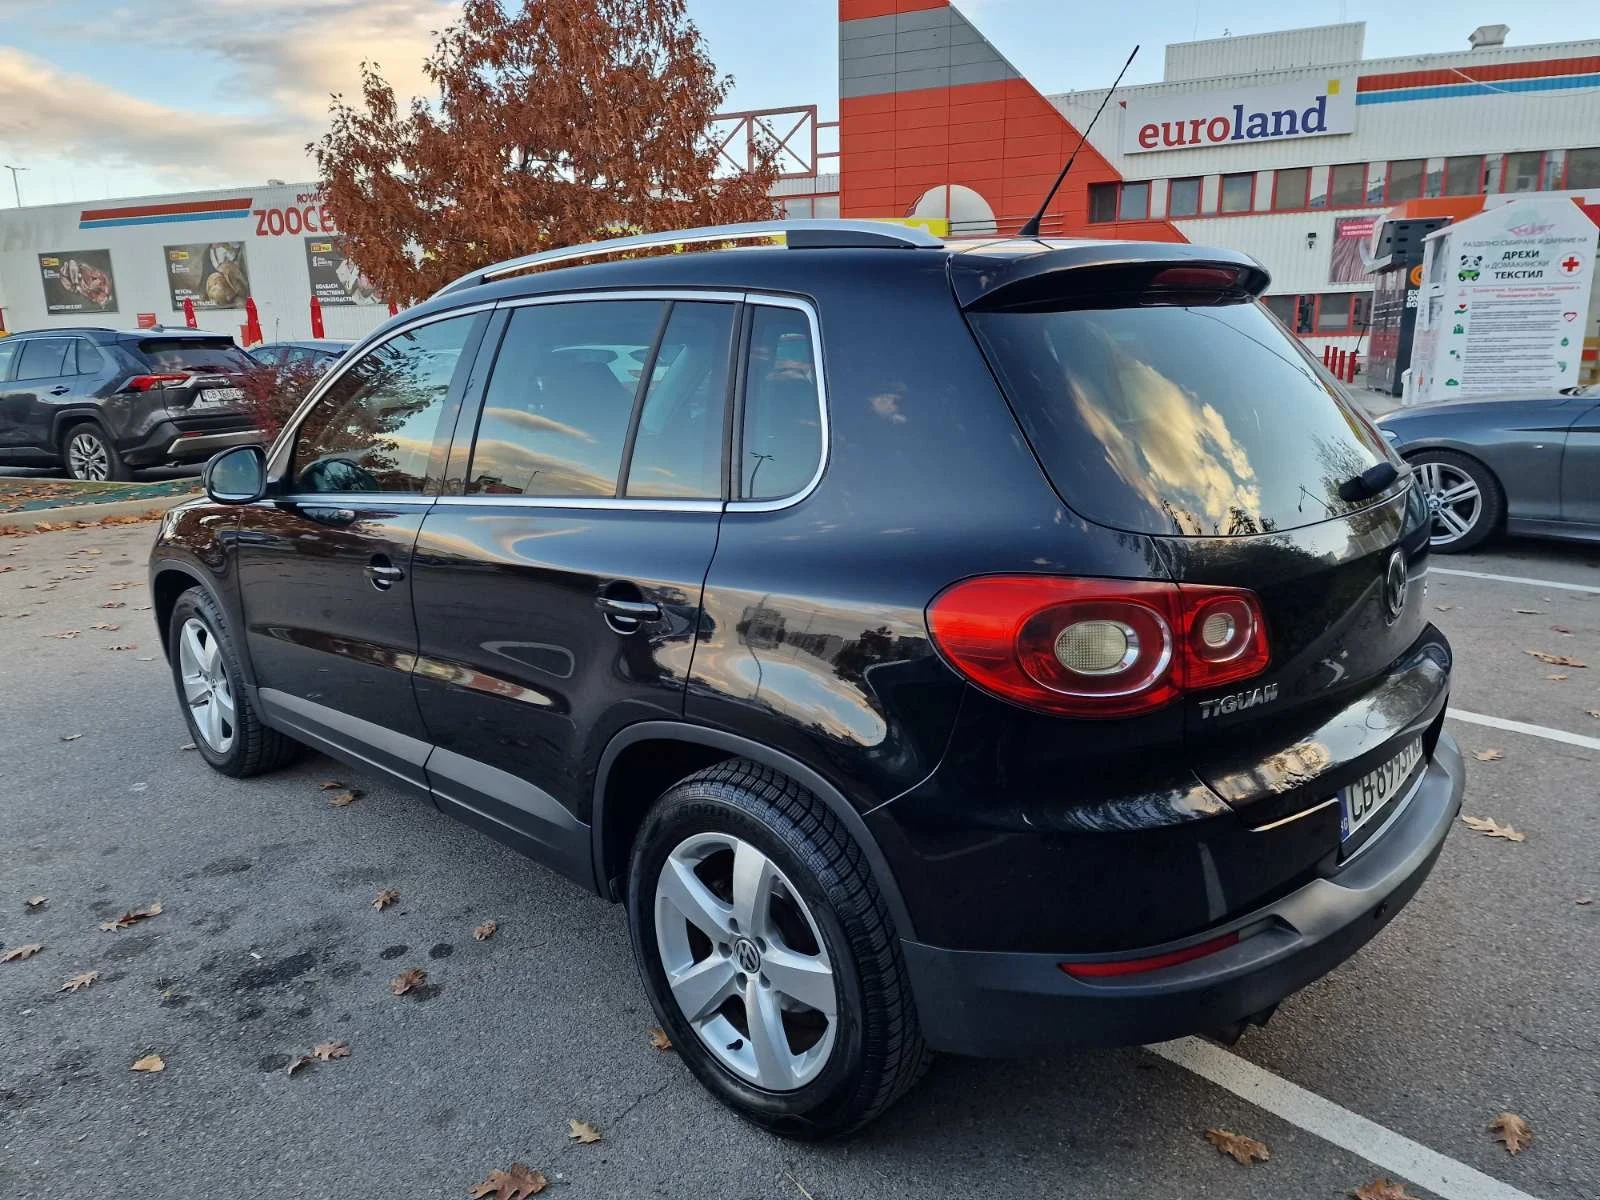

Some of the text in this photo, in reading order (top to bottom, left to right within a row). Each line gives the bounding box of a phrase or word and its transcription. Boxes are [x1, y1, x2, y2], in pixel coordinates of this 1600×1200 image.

[1138, 95, 1327, 149] euroland
[253, 205, 335, 236] ZOOCE
[1502, 250, 1540, 260] ДРЕХИ
[1494, 270, 1543, 280] ТЕКСТИЛ
[1198, 683, 1278, 719] TIGUAN
